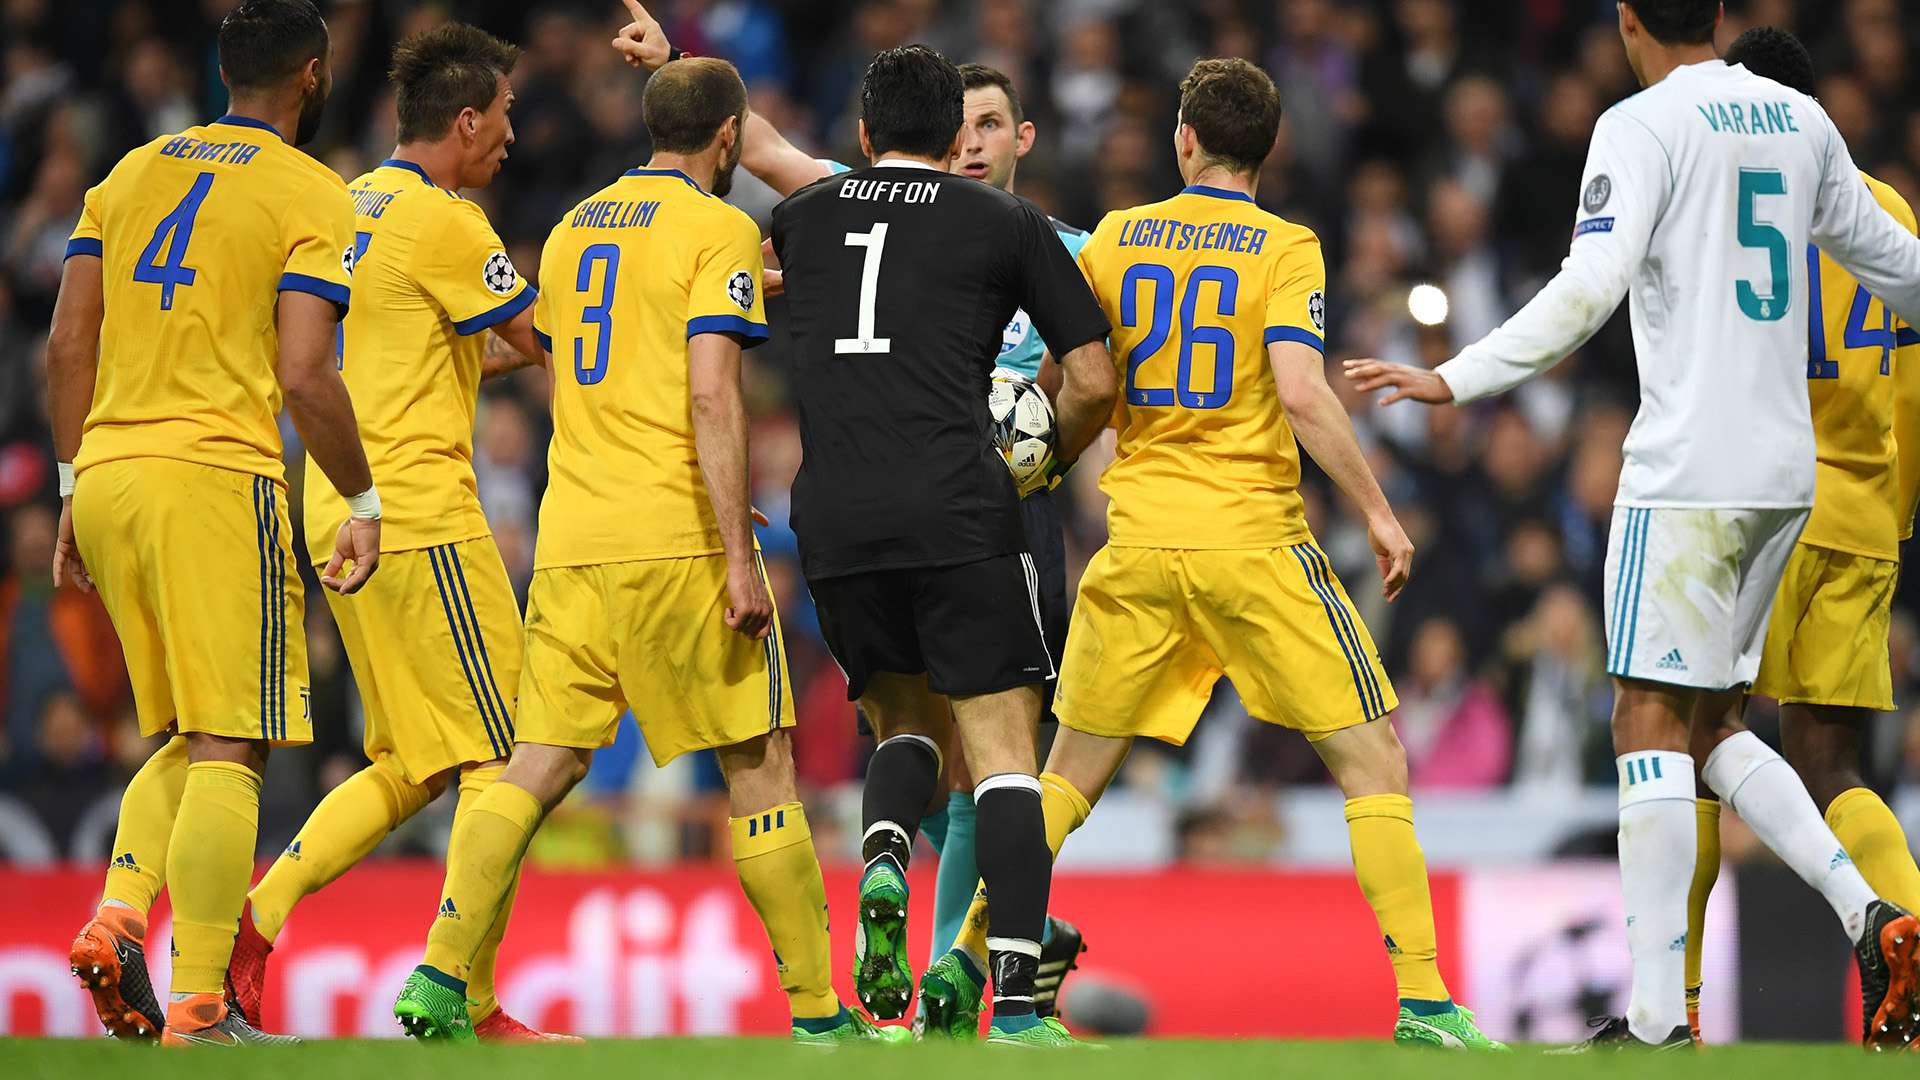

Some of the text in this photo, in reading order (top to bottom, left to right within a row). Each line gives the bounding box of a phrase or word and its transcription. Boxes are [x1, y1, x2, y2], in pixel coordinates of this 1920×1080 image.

[160, 136, 261, 165] BENATIA
[1697, 102, 1799, 135] VARANE
[133, 172, 215, 310] 4
[571, 201, 661, 229] CHIELLINI
[839, 179, 940, 204] BUFFON
[1118, 218, 1267, 256] LICHTSTEINER
[1735, 166, 1791, 322] 5
[574, 243, 620, 385] 3
[835, 222, 891, 354] 1
[1120, 263, 1239, 409] 26
[1806, 241, 1897, 377] 14
